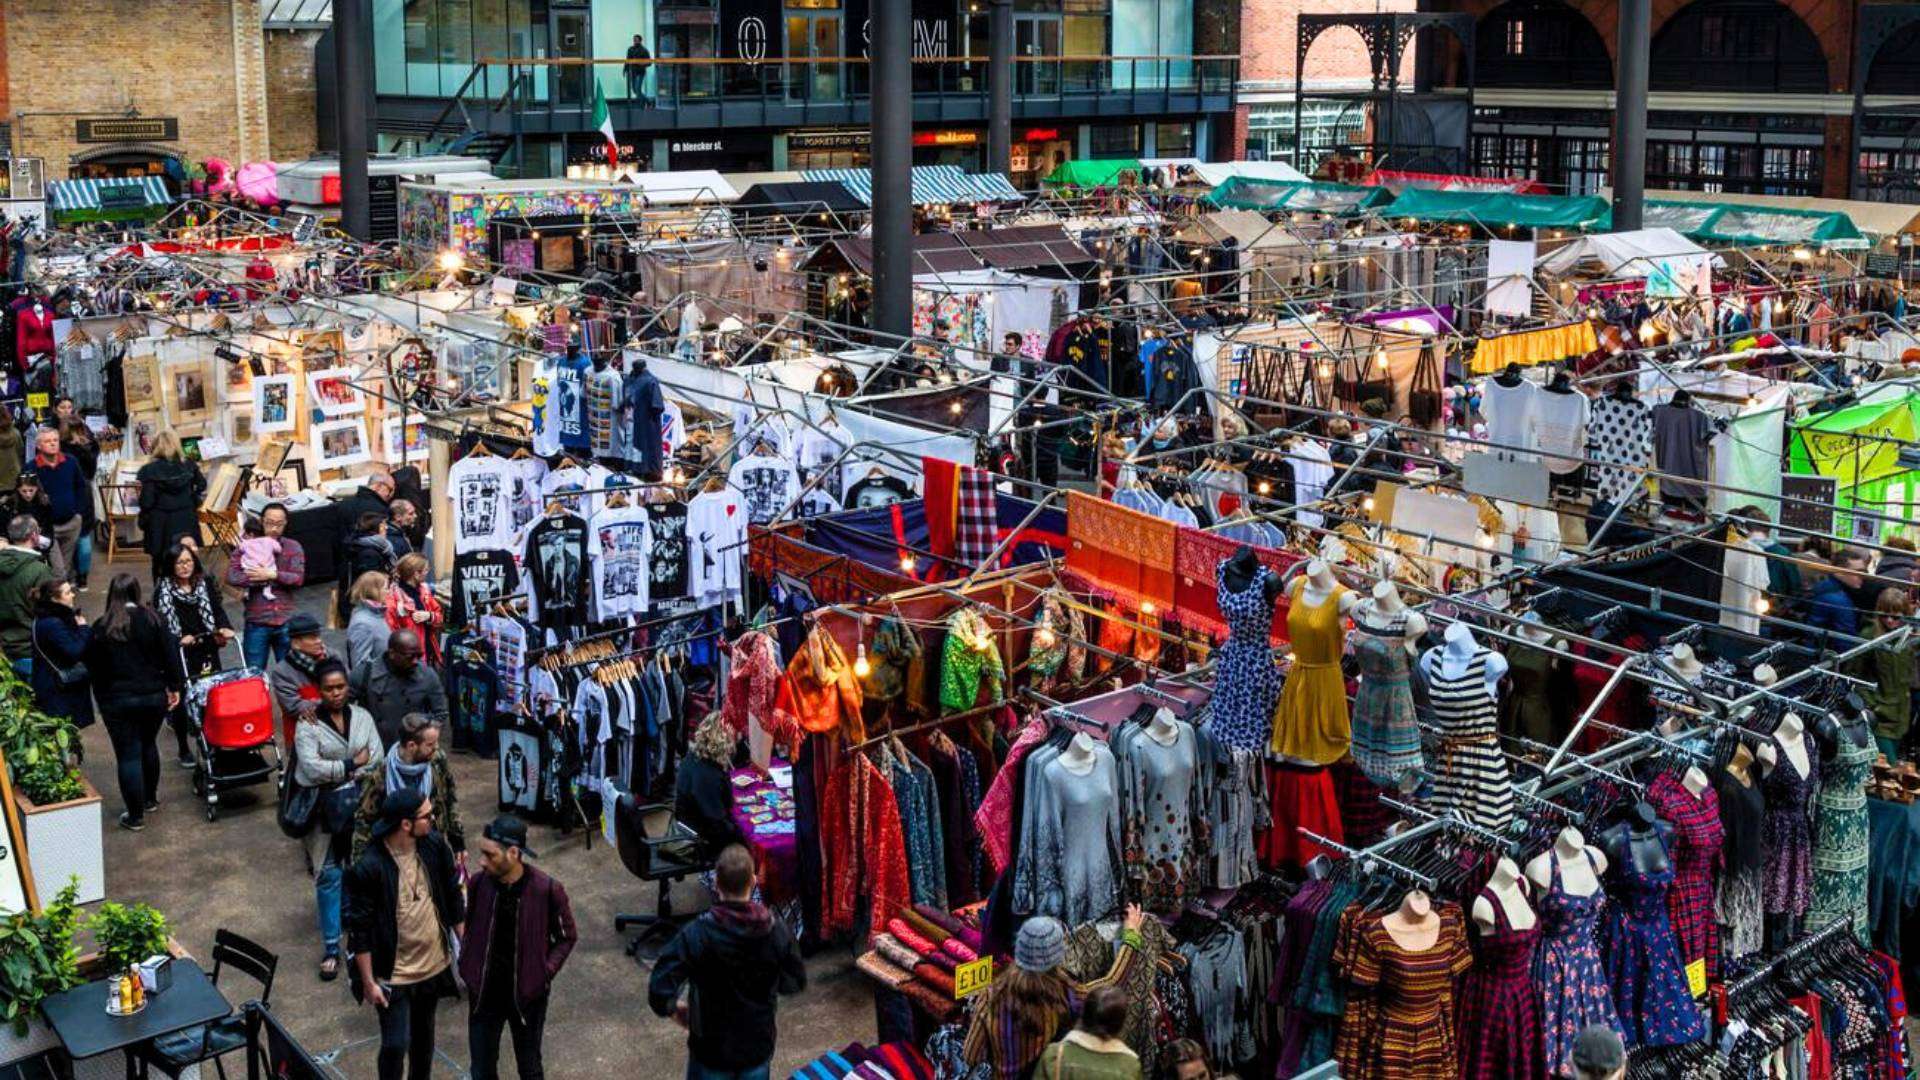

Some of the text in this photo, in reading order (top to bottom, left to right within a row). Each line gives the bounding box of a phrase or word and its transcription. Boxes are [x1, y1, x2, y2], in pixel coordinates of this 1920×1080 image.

[682, 141, 713, 152] bleecker
[461, 565, 506, 578] VINYL
[959, 965, 988, 990] £10
